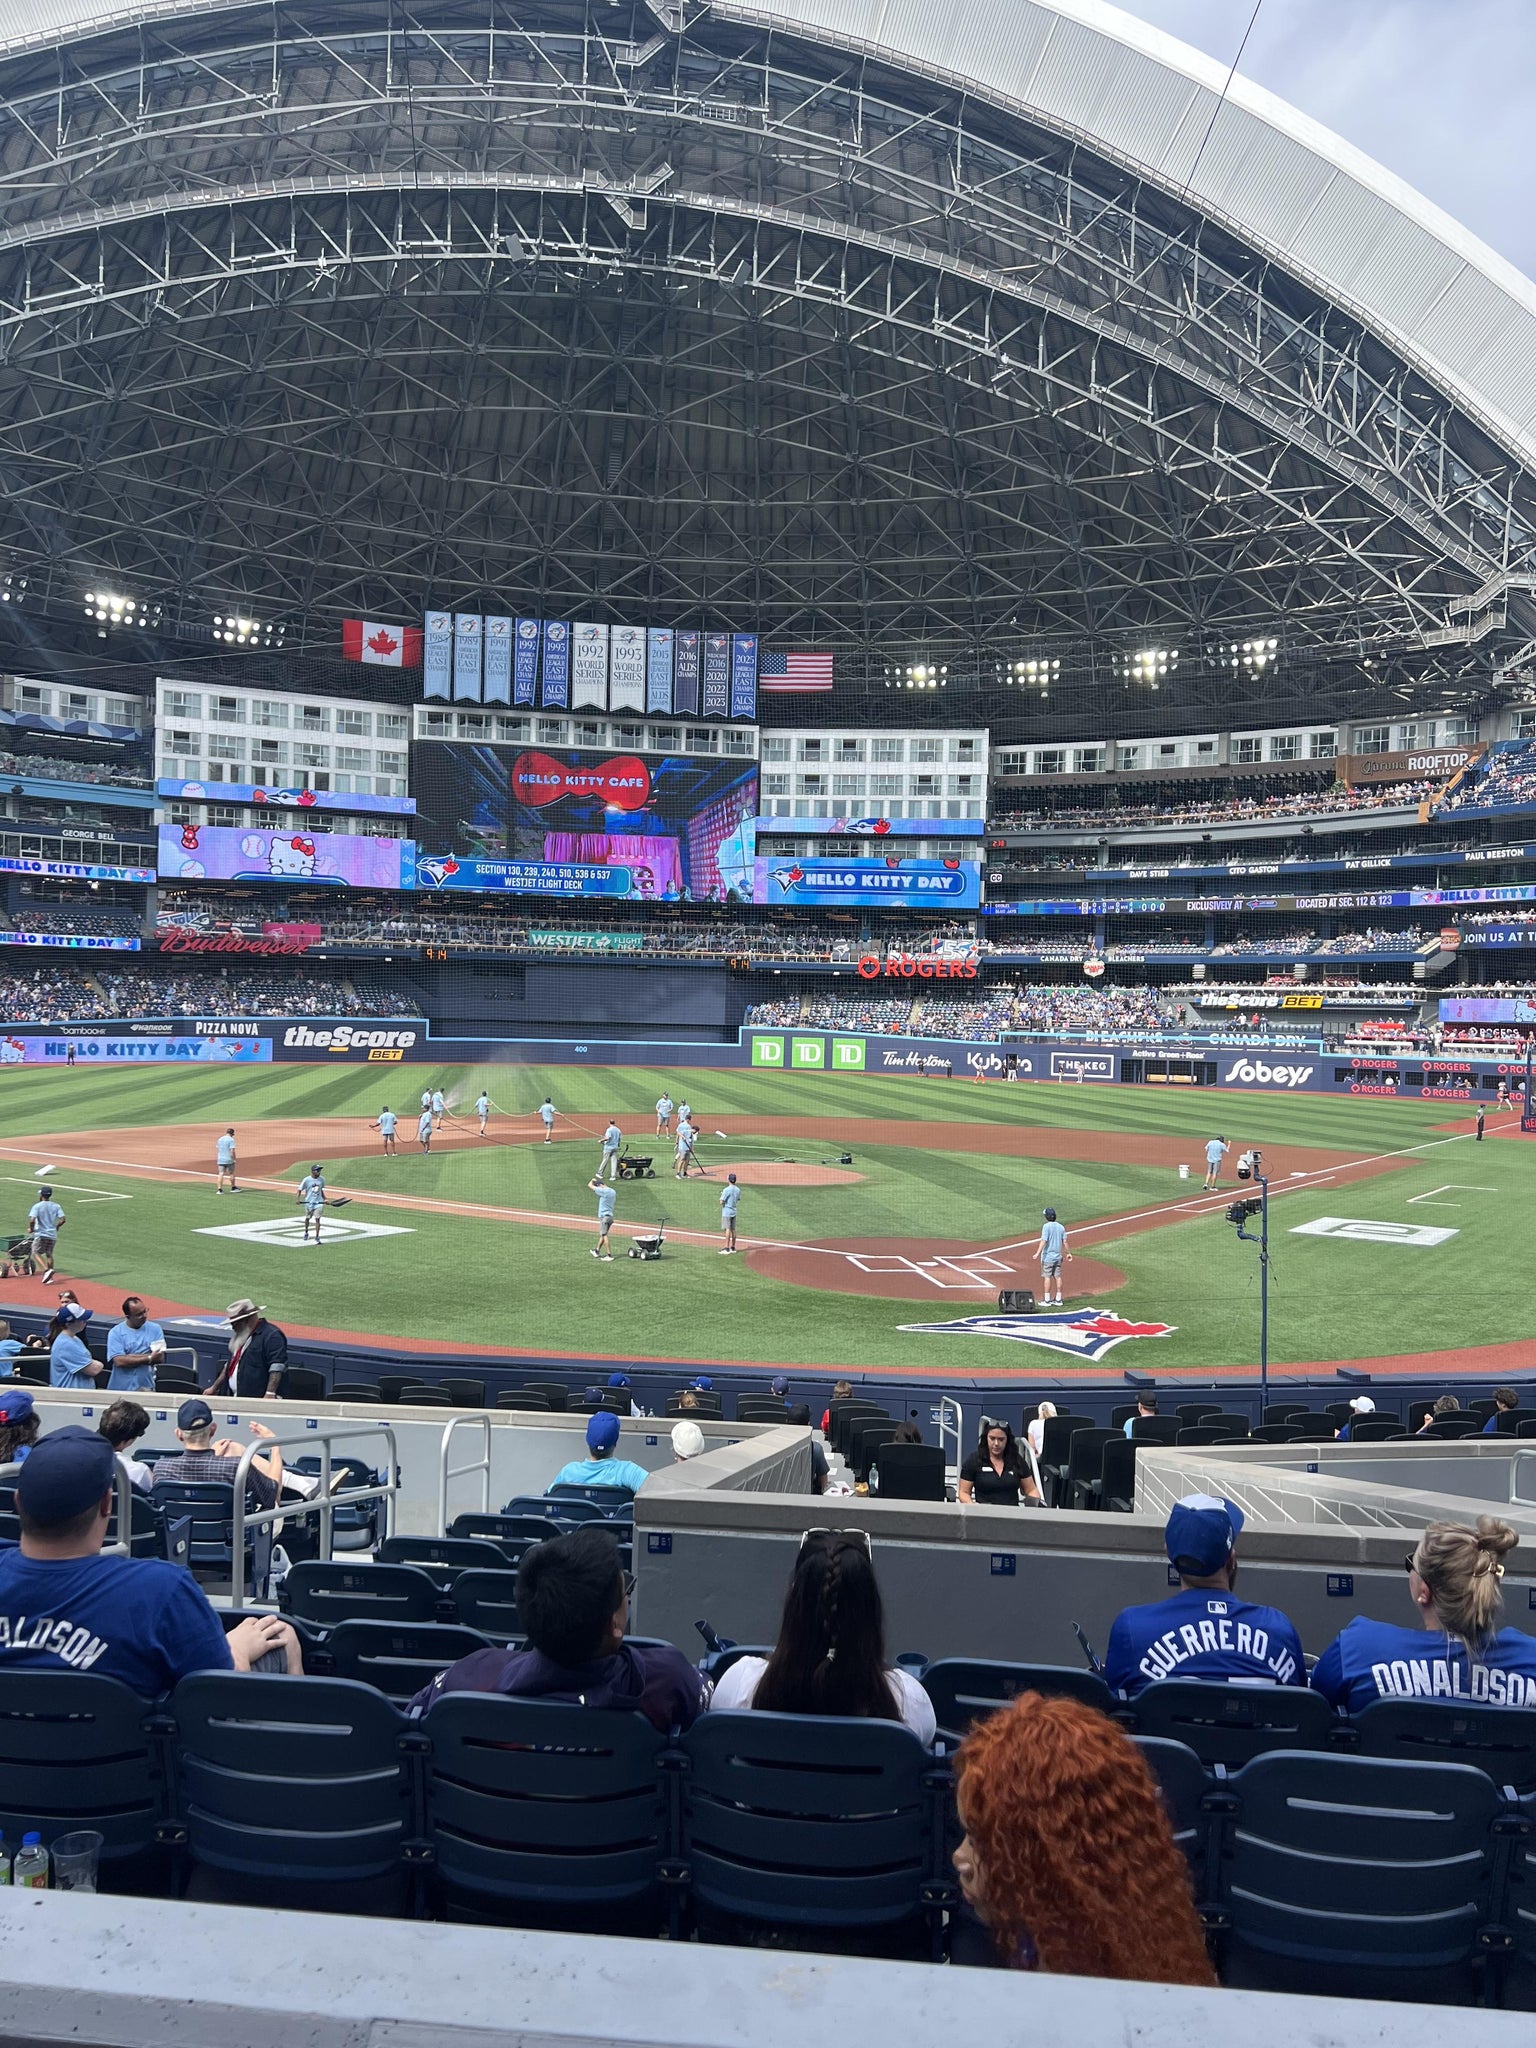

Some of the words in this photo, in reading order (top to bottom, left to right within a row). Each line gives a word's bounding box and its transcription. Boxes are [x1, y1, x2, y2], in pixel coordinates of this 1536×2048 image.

[460, 637, 478, 645] 1989
[548, 642, 565, 652] 1993
[578, 645, 604, 658] 1992
[616, 648, 642, 660] 1993
[652, 650, 668, 658] 2015
[679, 652, 696, 660] 2016
[428, 657, 447, 665] EAST
[576, 660, 604, 669] WORLD
[708, 659, 726, 667] 2016
[736, 655, 754, 664] 2025
[546, 666, 565, 674] EAST
[614, 662, 642, 672] WORLD
[678, 663, 696, 672] ALDS
[576, 670, 604, 678] SERIES
[614, 672, 642, 681] SERIES
[707, 672, 726, 680] 2020
[546, 685, 565, 694] ALCS
[706, 685, 725, 694] 2022
[651, 691, 668, 699] ALDS
[735, 696, 753, 704] ALCS
[706, 698, 725, 706] 2023
[1408, 753, 1468, 770] ROOFTOP
[518, 774, 560, 784] HELLO
[566, 776, 604, 786] KITTY
[608, 778, 643, 787] CAFE
[62, 830, 94, 839] GEORGE
[1465, 852, 1485, 861] PAUL
[1486, 849, 1524, 859] BEESTON
[0, 859, 41, 872] HELLO
[48, 864, 93, 876] KITTY
[97, 867, 128, 878] DAY
[1346, 861, 1359, 869] PAT
[1361, 859, 1391, 868] GILLICK
[476, 864, 506, 875] SECTION
[508, 865, 522, 876] 130,
[524, 867, 540, 877] 239,
[542, 868, 557, 878] 240,
[559, 869, 573, 878] 510,
[575, 870, 588, 879] 536
[591, 870, 595, 879] &
[597, 870, 610, 879] 537
[1249, 866, 1279, 874] GASTON
[505, 877, 536, 887] WESTJET
[538, 879, 562, 888] FLIGHT
[564, 880, 582, 890] DECK
[806, 874, 856, 886] HELLO
[862, 874, 913, 888] KITTY
[917, 876, 953, 889] DAY
[1440, 890, 1480, 901] HELLO
[1485, 887, 1529, 899] KITTY
[1187, 901, 1232, 910] EXCLUSIVELY
[1234, 900, 1243, 910] AT
[1296, 898, 1327, 909] LOCATED
[1328, 897, 1337, 908] AT
[1338, 897, 1354, 907] SEC.
[1357, 896, 1368, 906] 112
[1370, 896, 1377, 906] &
[1379, 895, 1392, 905] 123
[0, 933, 36, 943] HELLO
[42, 936, 81, 946] KITTY
[88, 938, 114, 947] DAY
[160, 927, 309, 955] Budweiser
[532, 934, 595, 949] WESTJET
[1464, 933, 1486, 944] JOIN
[1490, 932, 1504, 942] US
[1508, 932, 1523, 941] AT
[886, 959, 976, 978] ROGERS
[1201, 993, 1280, 1006] theScore
[1285, 997, 1320, 1006] BET
[196, 1022, 227, 1035] PIZZA
[230, 1023, 259, 1035] NOVA
[284, 1026, 416, 1048] theScore
[1209, 1033, 1269, 1045] CANADA
[106, 1043, 160, 1056] KITTY
[165, 1044, 202, 1056] DAY
[756, 1042, 781, 1061] TD
[796, 1043, 821, 1062] TD
[836, 1044, 861, 1063] TD
[1132, 1050, 1156, 1058] Active
[371, 1051, 400, 1059] BET
[883, 1052, 905, 1066] Tim
[1083, 1061, 1107, 1070] KEG
[1362, 1060, 1397, 1068] ROGERS
[1434, 1063, 1471, 1072] ROGERS
[1225, 1058, 1314, 1087] Sobeys
[1361, 1085, 1396, 1094] ROGERS
[1433, 1089, 1470, 1098] ROGERS
[1139, 1618, 1269, 1680] GUERRERO
